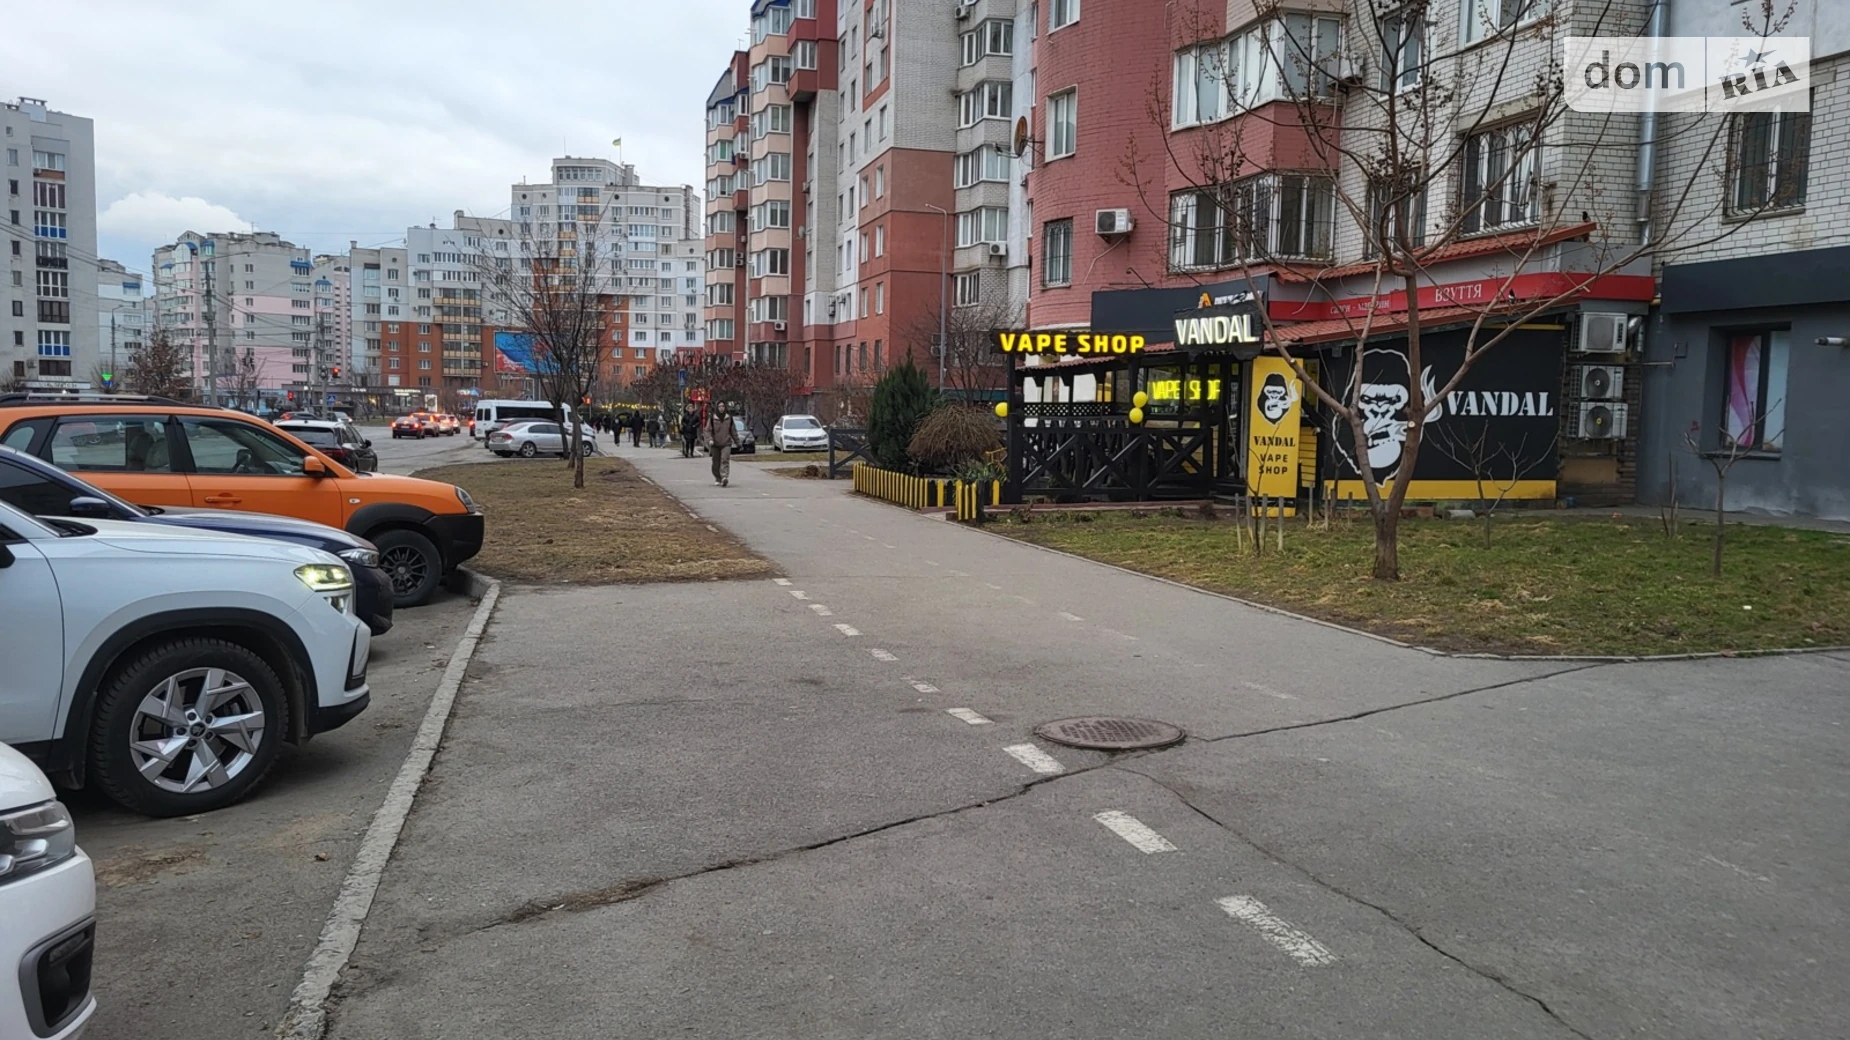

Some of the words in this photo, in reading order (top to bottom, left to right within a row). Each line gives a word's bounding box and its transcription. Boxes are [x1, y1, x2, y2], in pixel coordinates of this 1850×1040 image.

[1435, 284, 1482, 302] ВЗУТТЯ
[1175, 314, 1260, 345] VANDAL
[1000, 333, 1067, 353] VAPE
[1077, 335, 1145, 354] SHOP
[1153, 380, 1181, 400] VAPE
[1447, 391, 1553, 416] VANDAL
[1254, 435, 1295, 447] VANDAL
[1260, 454, 1288, 463] VAPE
[1259, 466, 1288, 475] SHOP
